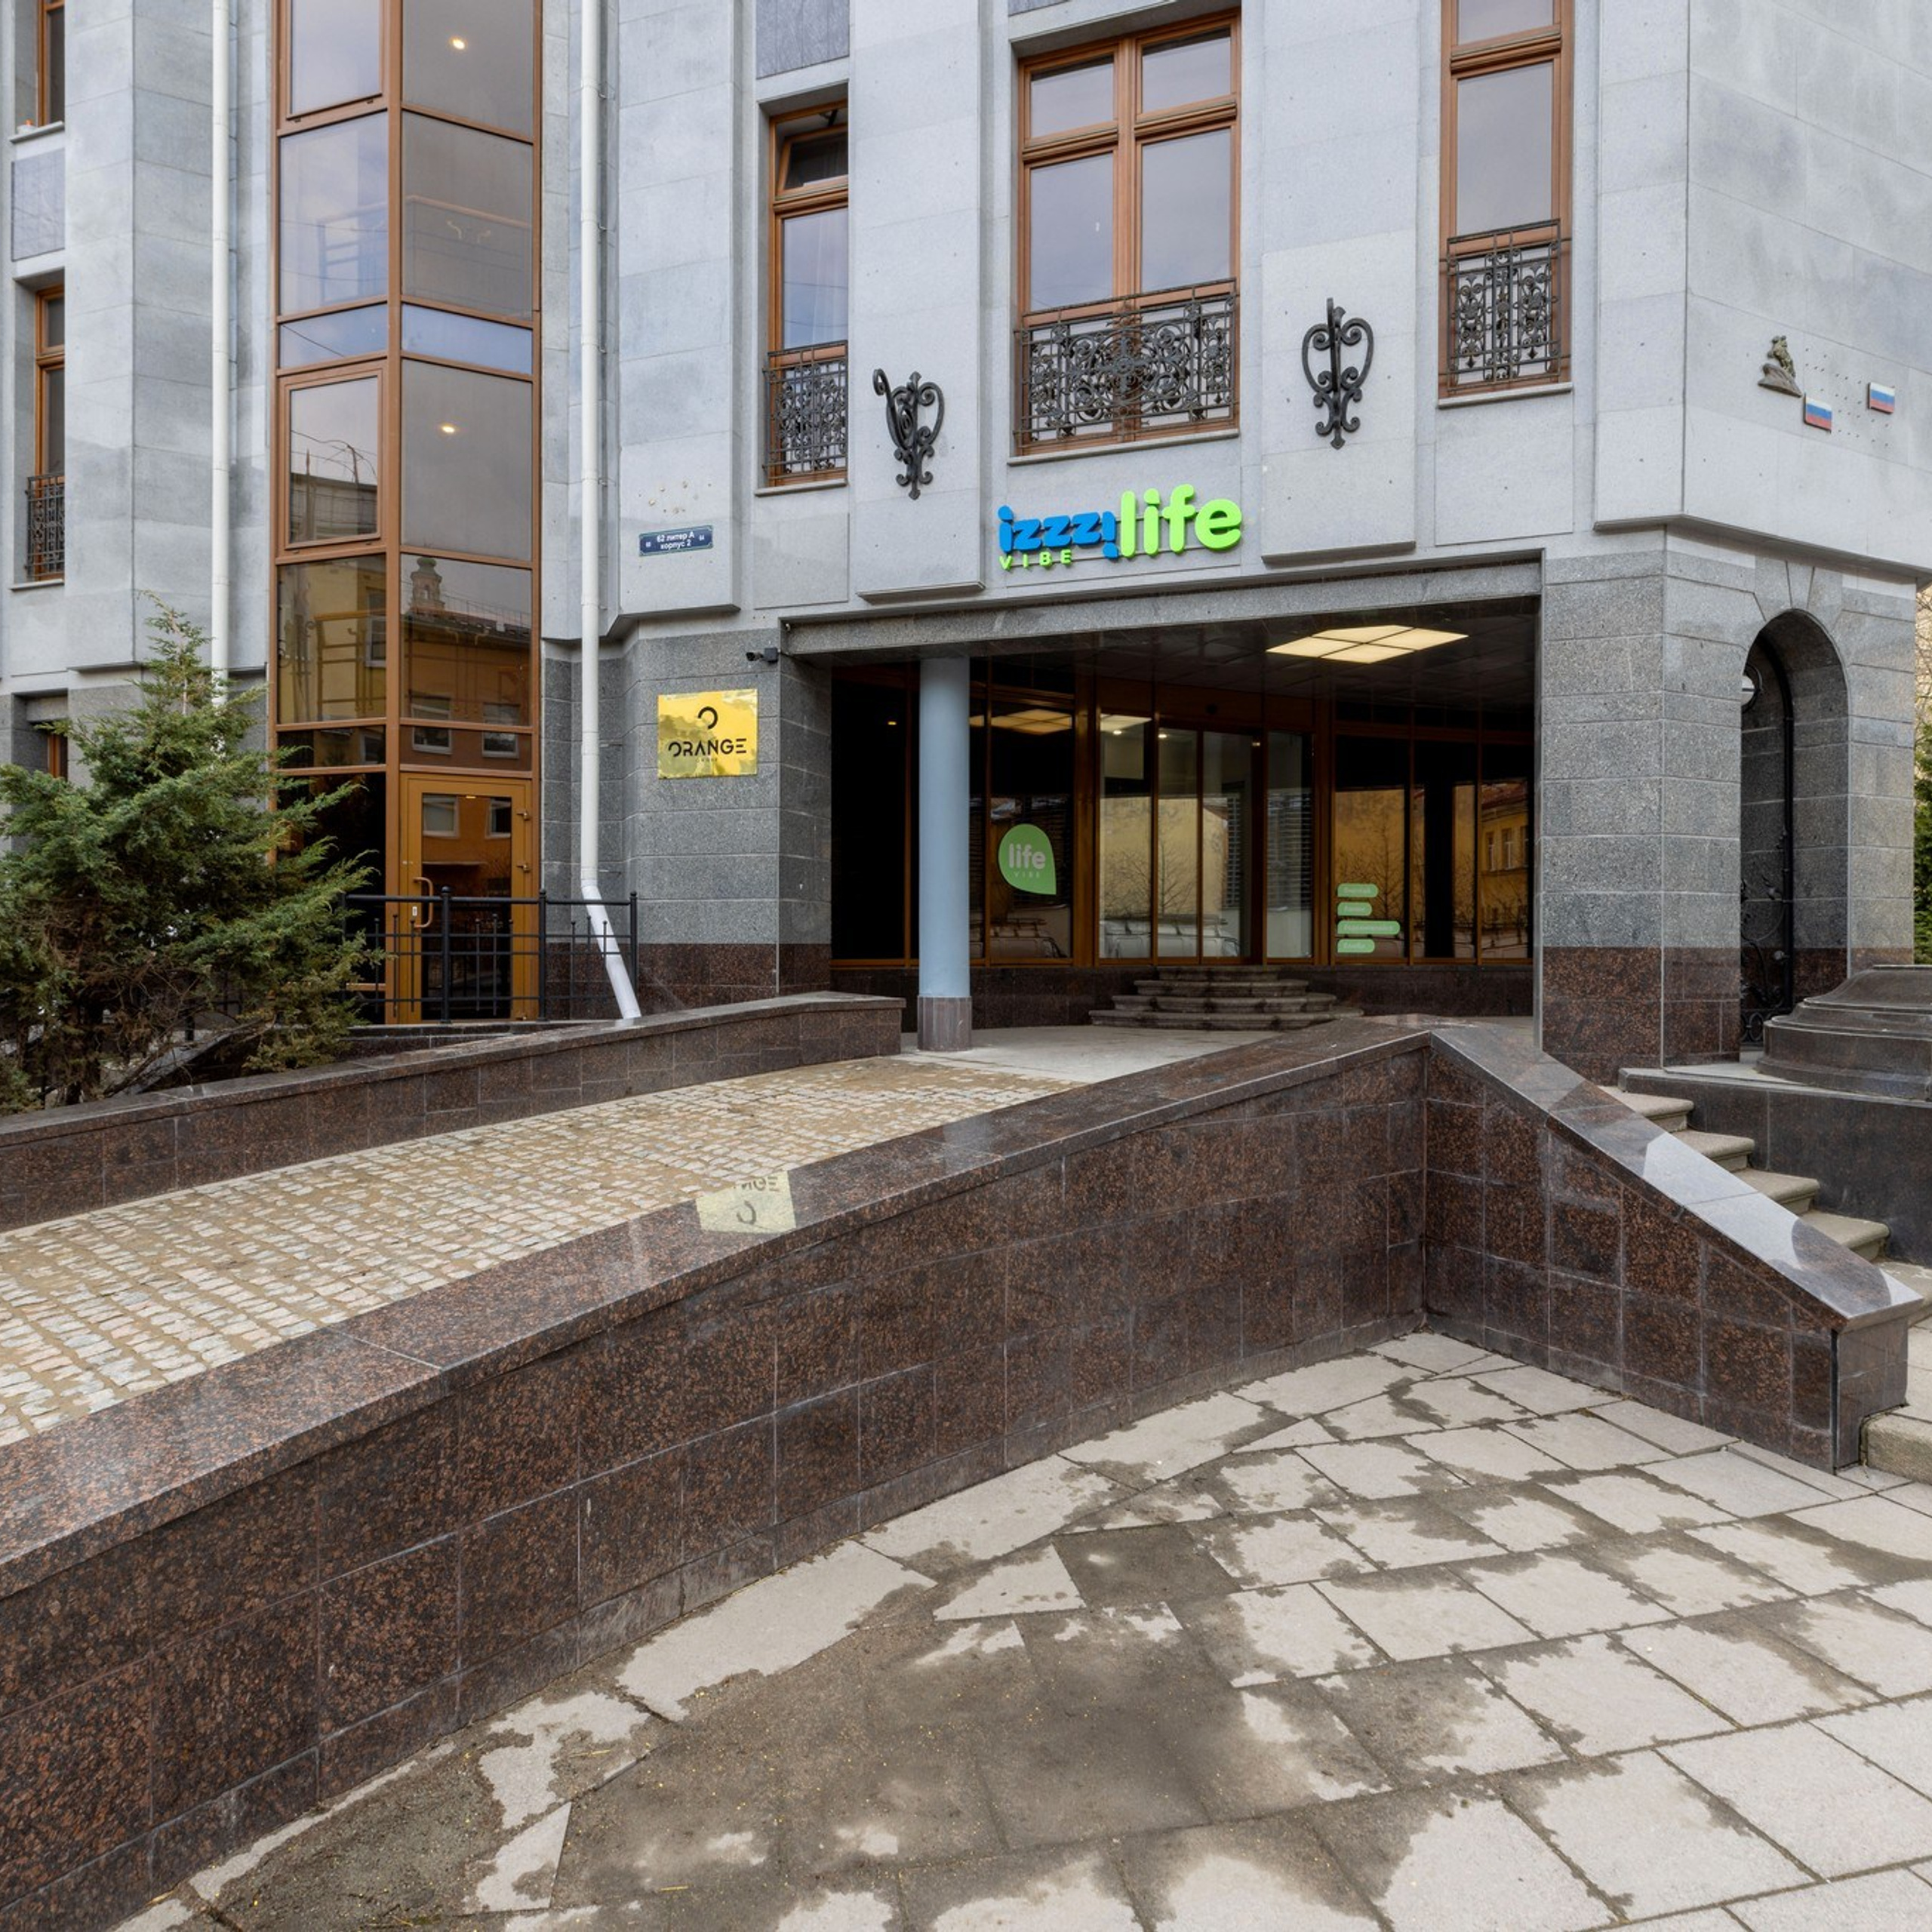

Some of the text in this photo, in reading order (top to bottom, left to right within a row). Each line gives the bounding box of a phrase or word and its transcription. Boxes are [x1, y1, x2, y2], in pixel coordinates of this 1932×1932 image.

[1121, 484, 1242, 558] life
[657, 534, 665, 543] 62
[666, 533, 688, 541] литер
[660, 539, 692, 549] корпус 2
[999, 549, 1072, 571] VIBE
[668, 738, 747, 758] ORANGE
[1009, 843, 1046, 869] life
